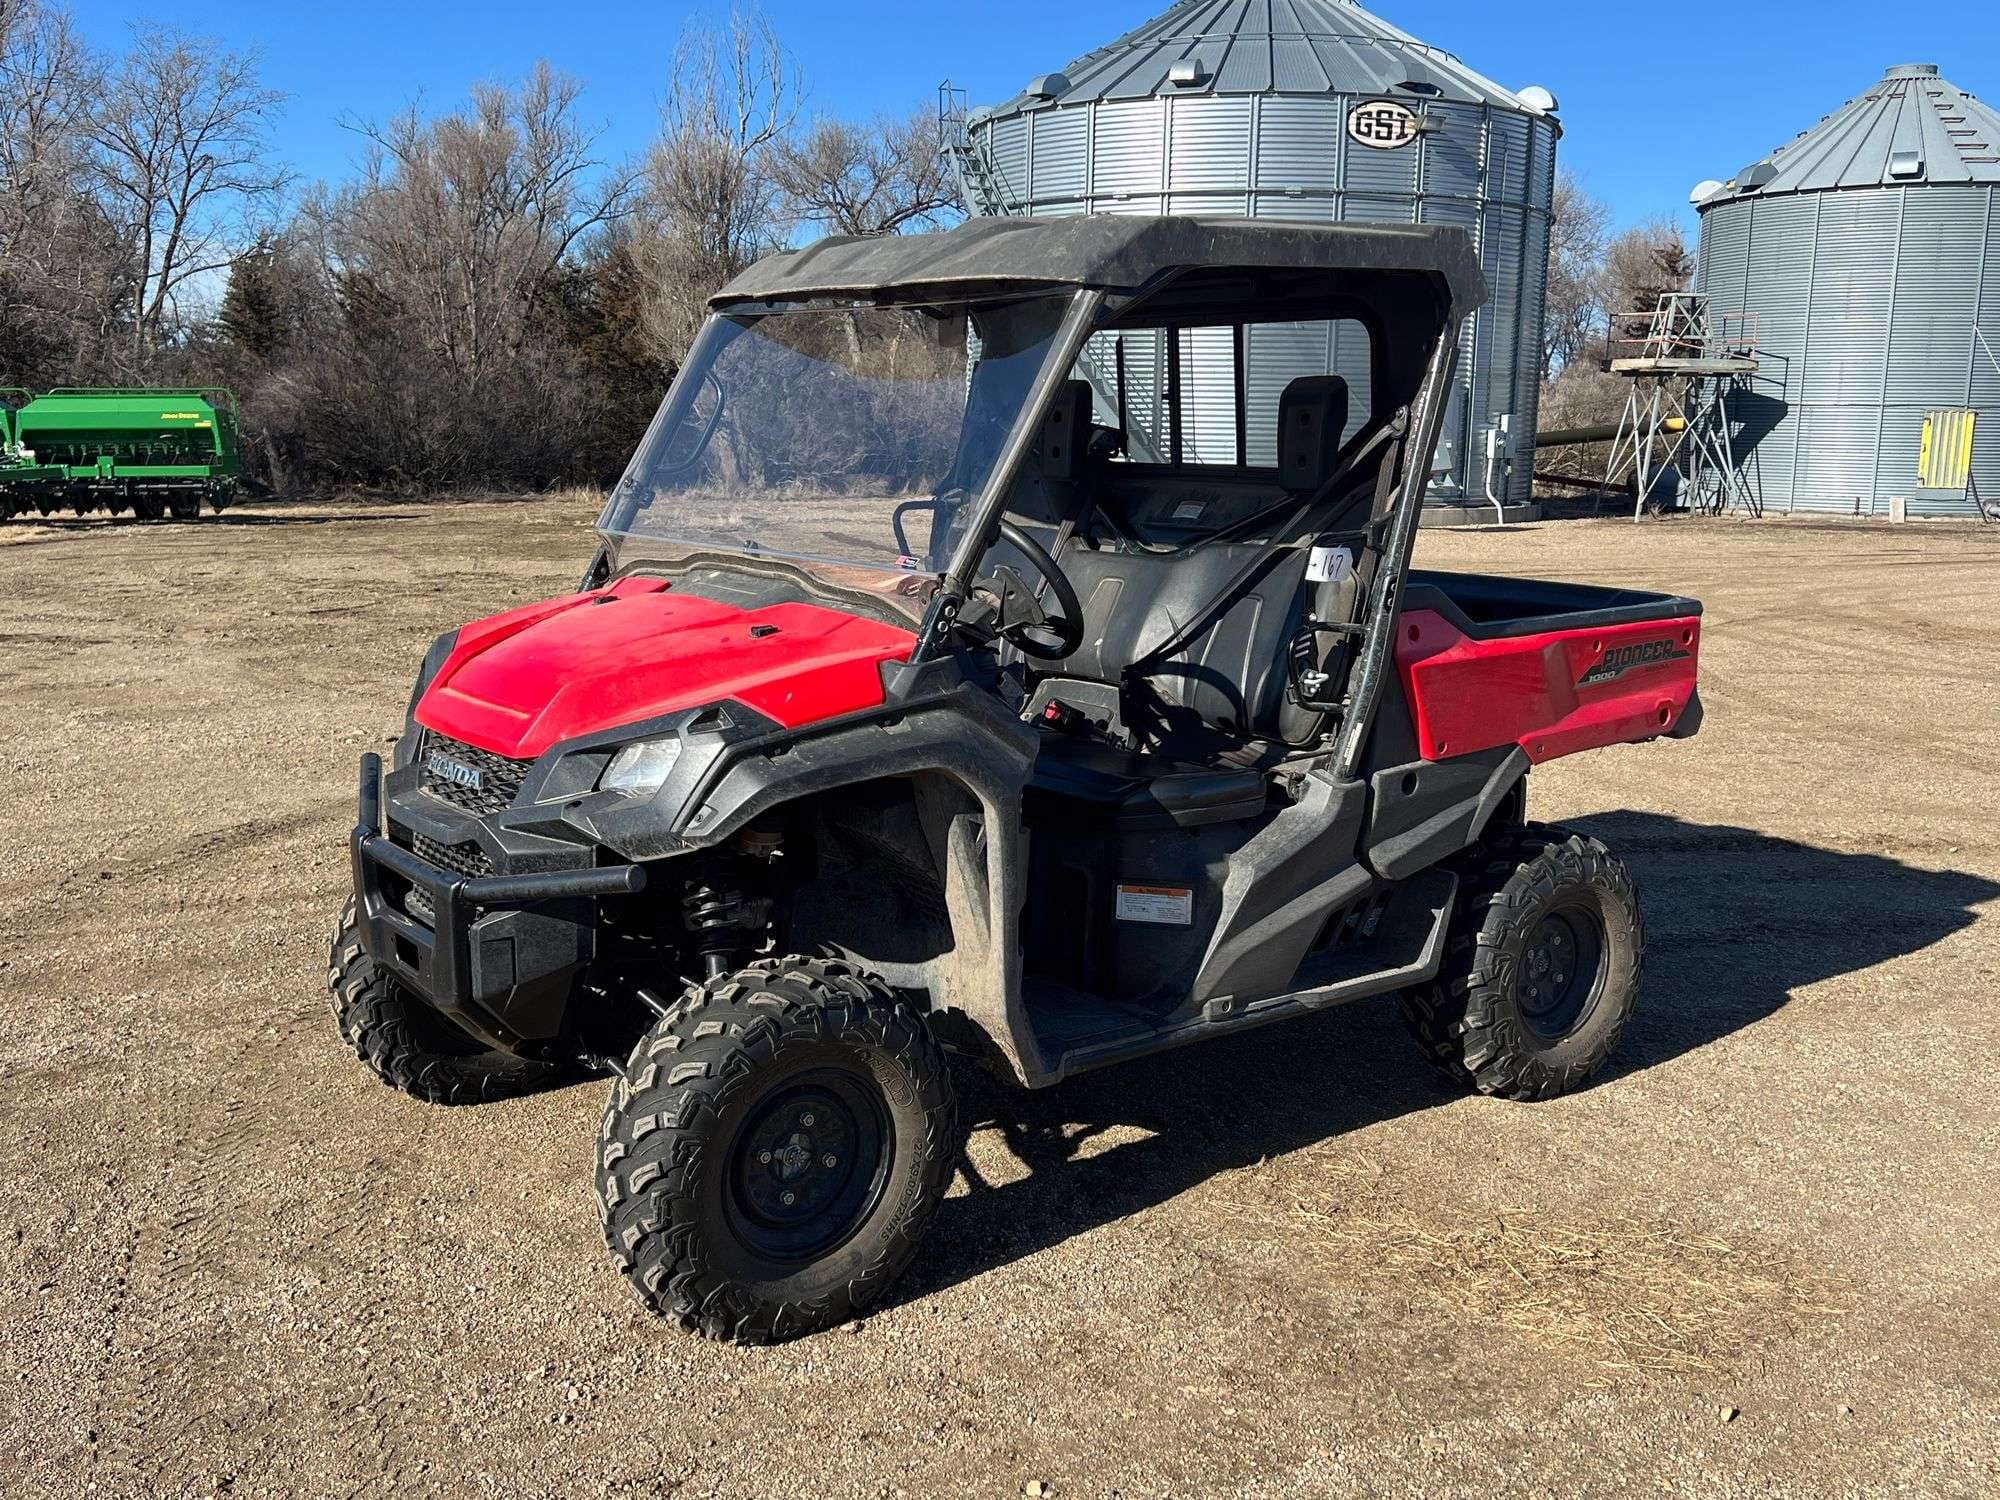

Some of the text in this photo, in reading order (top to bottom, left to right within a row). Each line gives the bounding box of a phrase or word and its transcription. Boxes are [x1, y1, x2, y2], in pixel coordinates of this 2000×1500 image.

[1356, 110, 1409, 140] GSI
[1321, 554, 1344, 578] 167
[1603, 640, 1675, 667] PIONEER
[1589, 671, 1616, 682] 1000
[428, 752, 481, 789] HONDA
